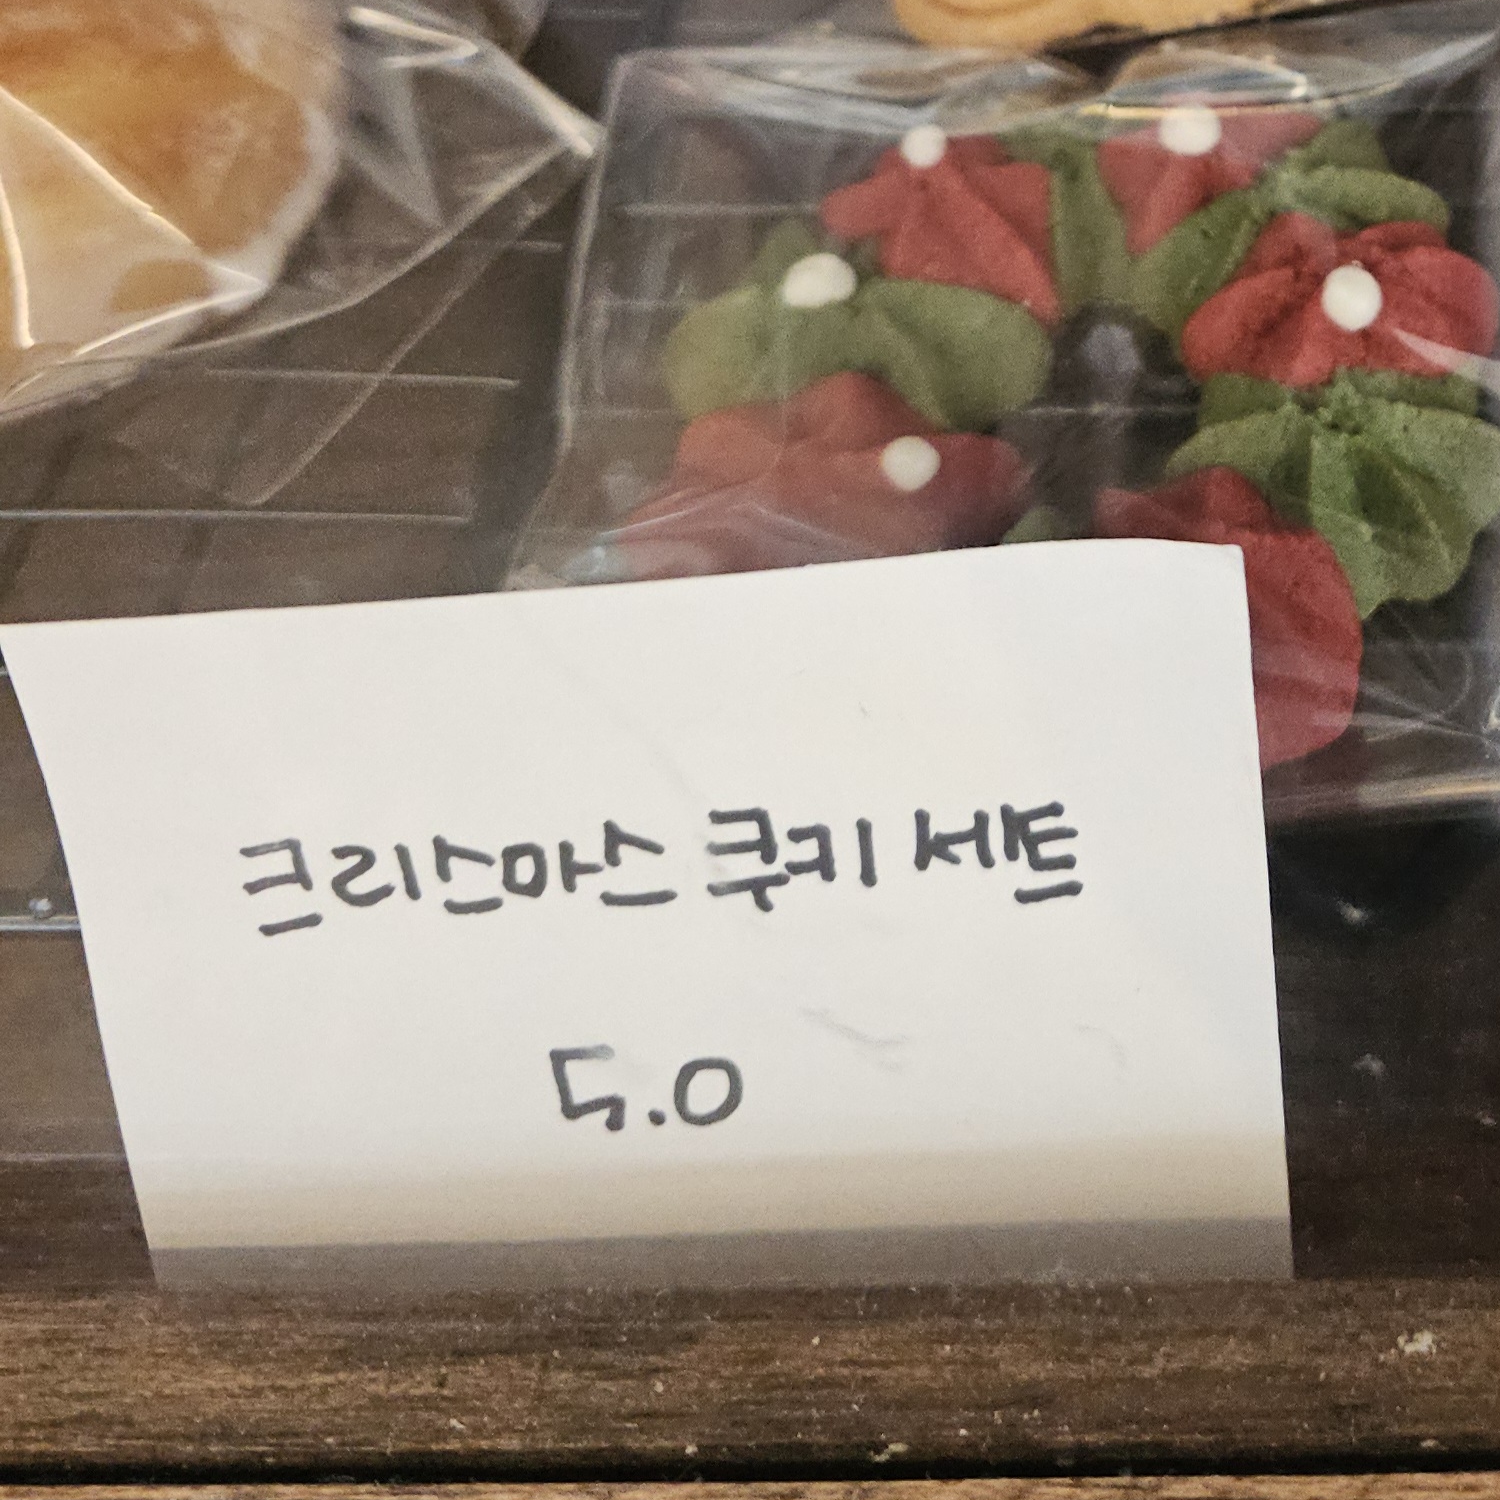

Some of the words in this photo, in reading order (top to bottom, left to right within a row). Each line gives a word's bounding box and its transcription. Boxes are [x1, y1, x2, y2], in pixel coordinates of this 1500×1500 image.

[239, 818, 679, 938] 크리스마스
[706, 806, 879, 913] 쿠키
[912, 800, 1085, 906] 세트
[547, 1043, 743, 1133] 5.0
